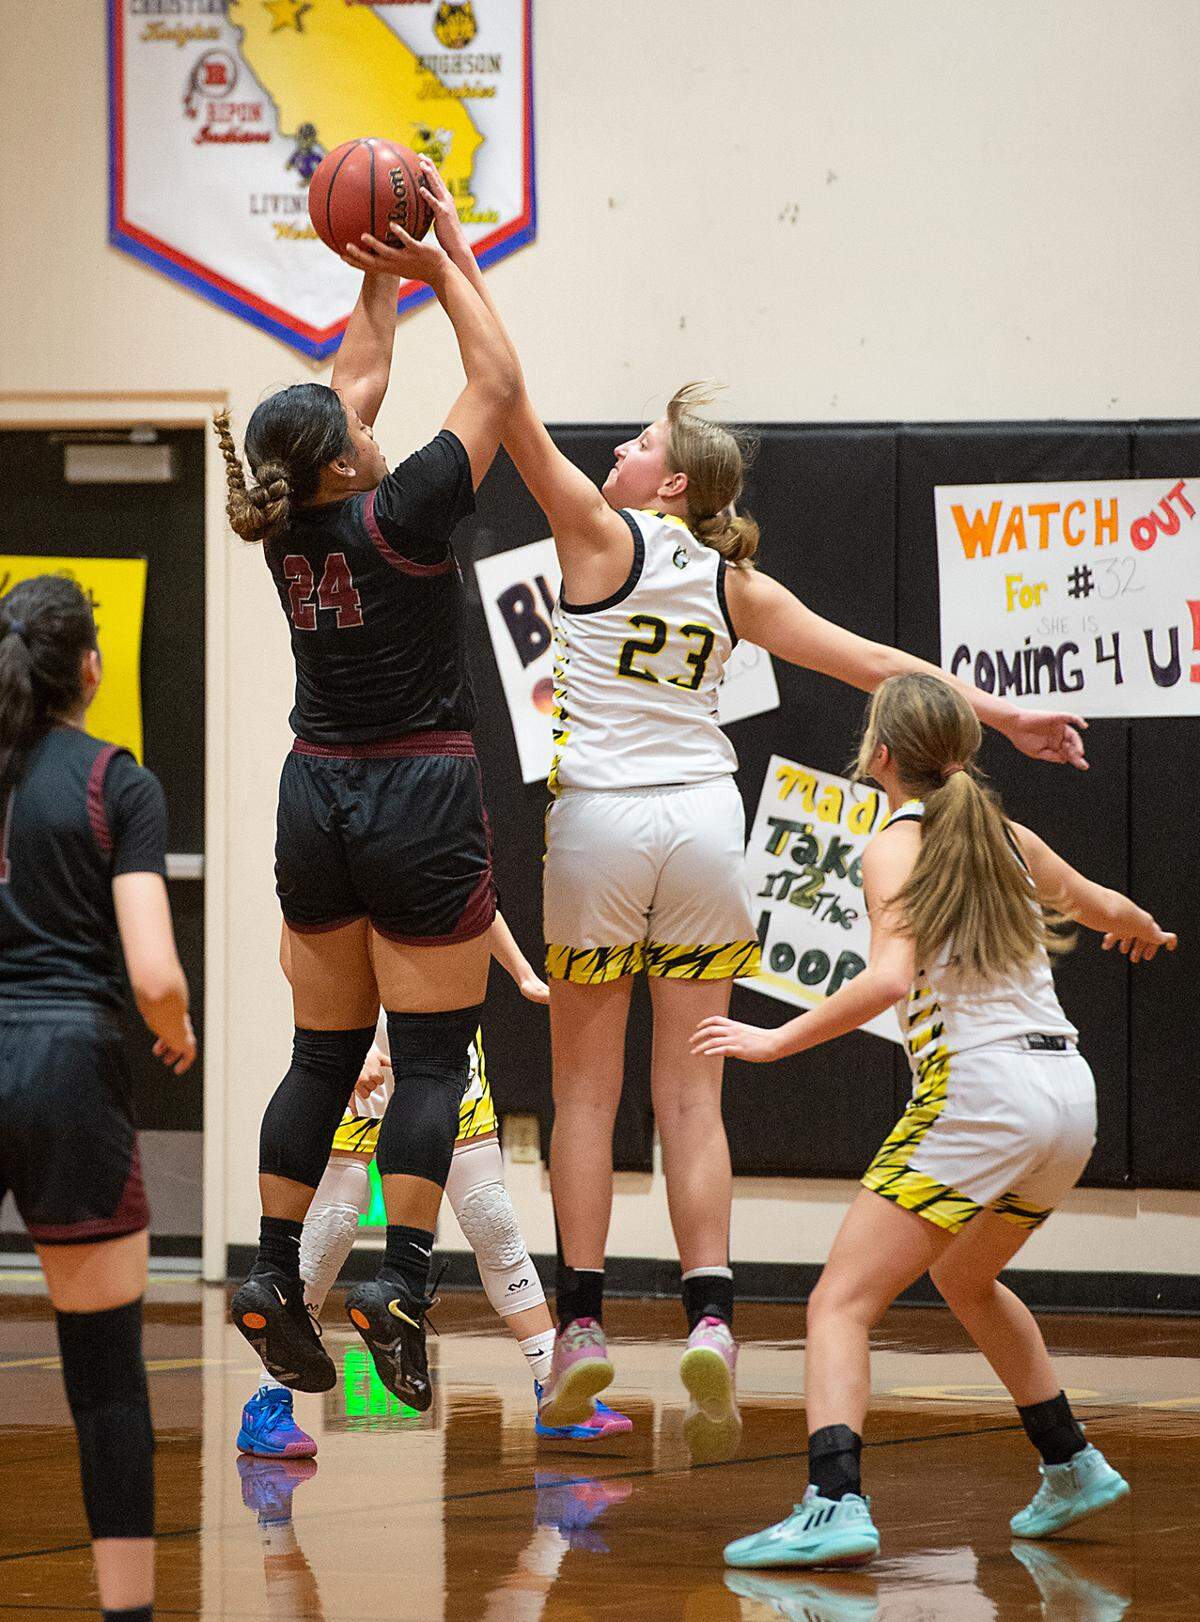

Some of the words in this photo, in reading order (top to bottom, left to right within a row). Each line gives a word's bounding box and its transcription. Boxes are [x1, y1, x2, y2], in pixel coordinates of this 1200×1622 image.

[950, 497, 1119, 560] WATCH
[1129, 479, 1196, 551] OUT
[283, 552, 365, 631] 24
[1005, 573, 1049, 613] For
[617, 614, 716, 691] 23
